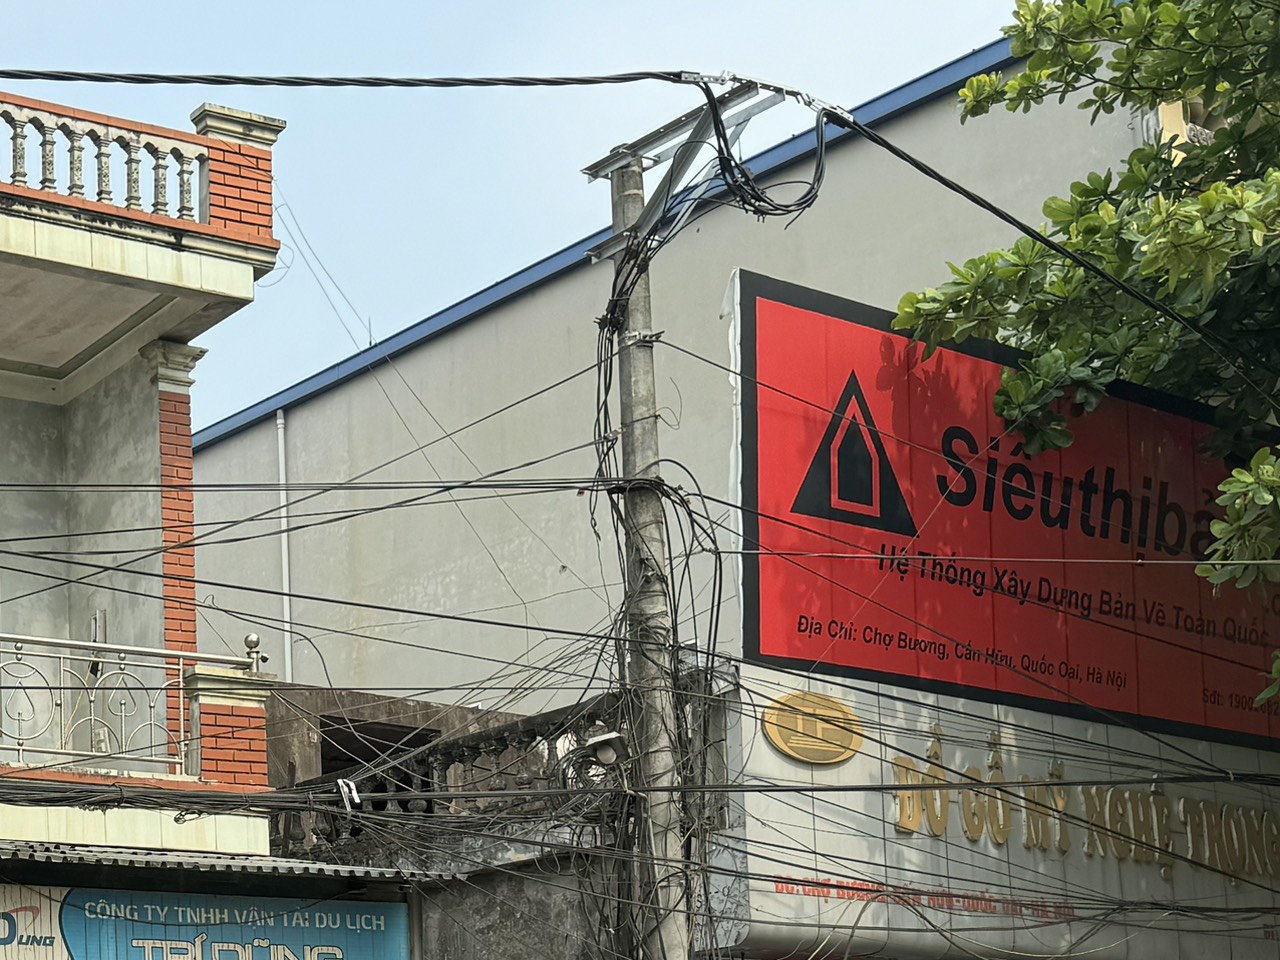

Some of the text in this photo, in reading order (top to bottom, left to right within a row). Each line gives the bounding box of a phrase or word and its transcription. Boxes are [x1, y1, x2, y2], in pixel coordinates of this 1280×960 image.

[879, 544, 909, 581] Hệ
[918, 551, 986, 596] Thống
[993, 567, 1031, 605] Xây
[1099, 591, 1136, 622] Bản
[797, 615, 822, 638] Địa
[828, 620, 858, 641] Chỉ:
[863, 626, 894, 651] Chợ
[897, 631, 949, 661] Bương,
[1021, 654, 1054, 676] Quốc
[1058, 661, 1083, 683] Oai,
[1086, 667, 1102, 684] Hà
[1106, 671, 1127, 692] Nội
[85, 899, 385, 933] CÔNG TY TNHH VẬN TẢI DU LỊCH
